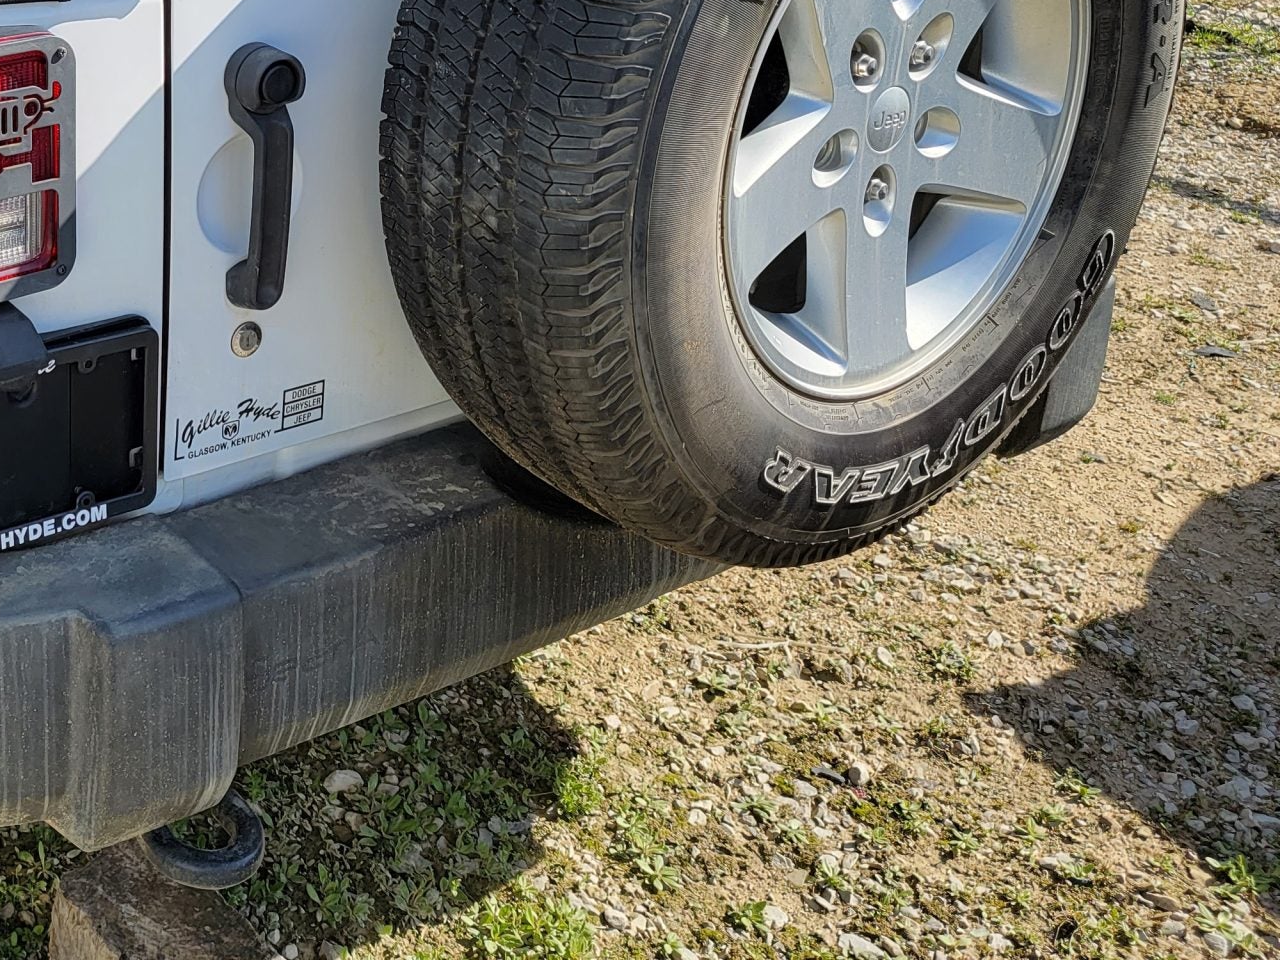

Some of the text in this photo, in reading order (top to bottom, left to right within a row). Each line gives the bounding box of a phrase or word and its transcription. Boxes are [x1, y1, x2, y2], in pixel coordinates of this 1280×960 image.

[873, 110, 907, 131] Jeep
[763, 228, 1115, 505] GOODYEAR
[291, 385, 317, 400] DODGE
[285, 397, 321, 414] CHRYSLER
[182, 398, 281, 449] Gillie Hyde
[293, 412, 312, 425] JEEP
[188, 429, 271, 460] GLASGOW, KENTUCKY
